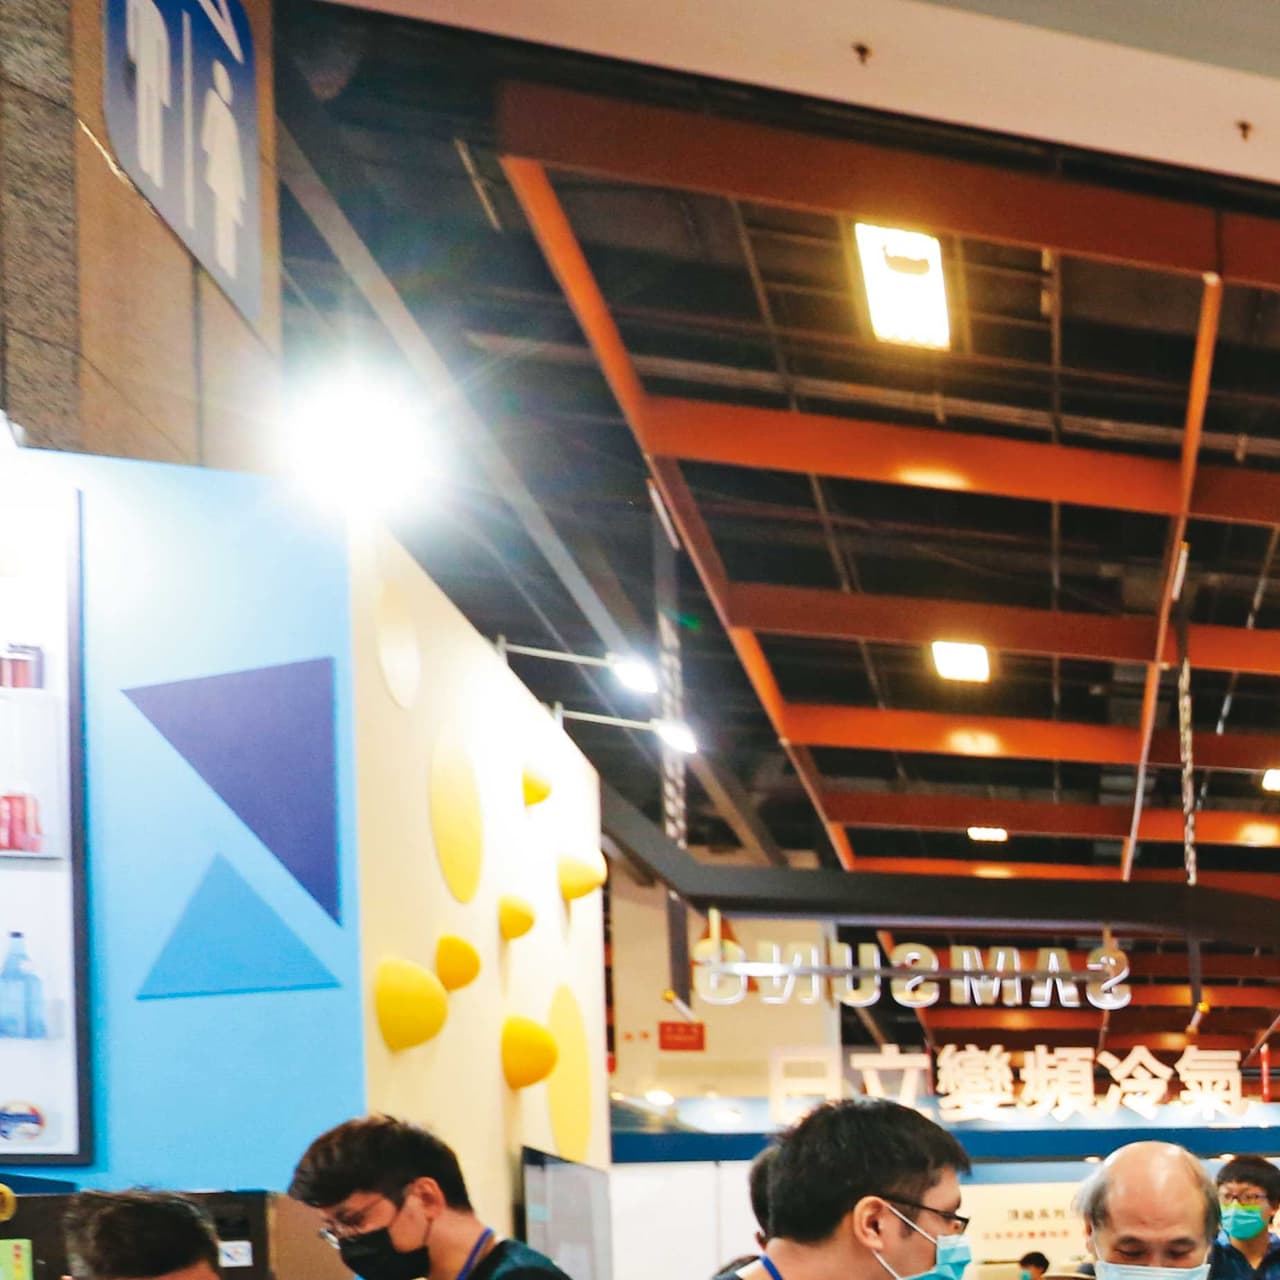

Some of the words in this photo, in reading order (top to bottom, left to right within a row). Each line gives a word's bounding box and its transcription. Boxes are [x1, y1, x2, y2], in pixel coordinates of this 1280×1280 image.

[769, 1043, 1249, 1123] 日立變頻冷氣
